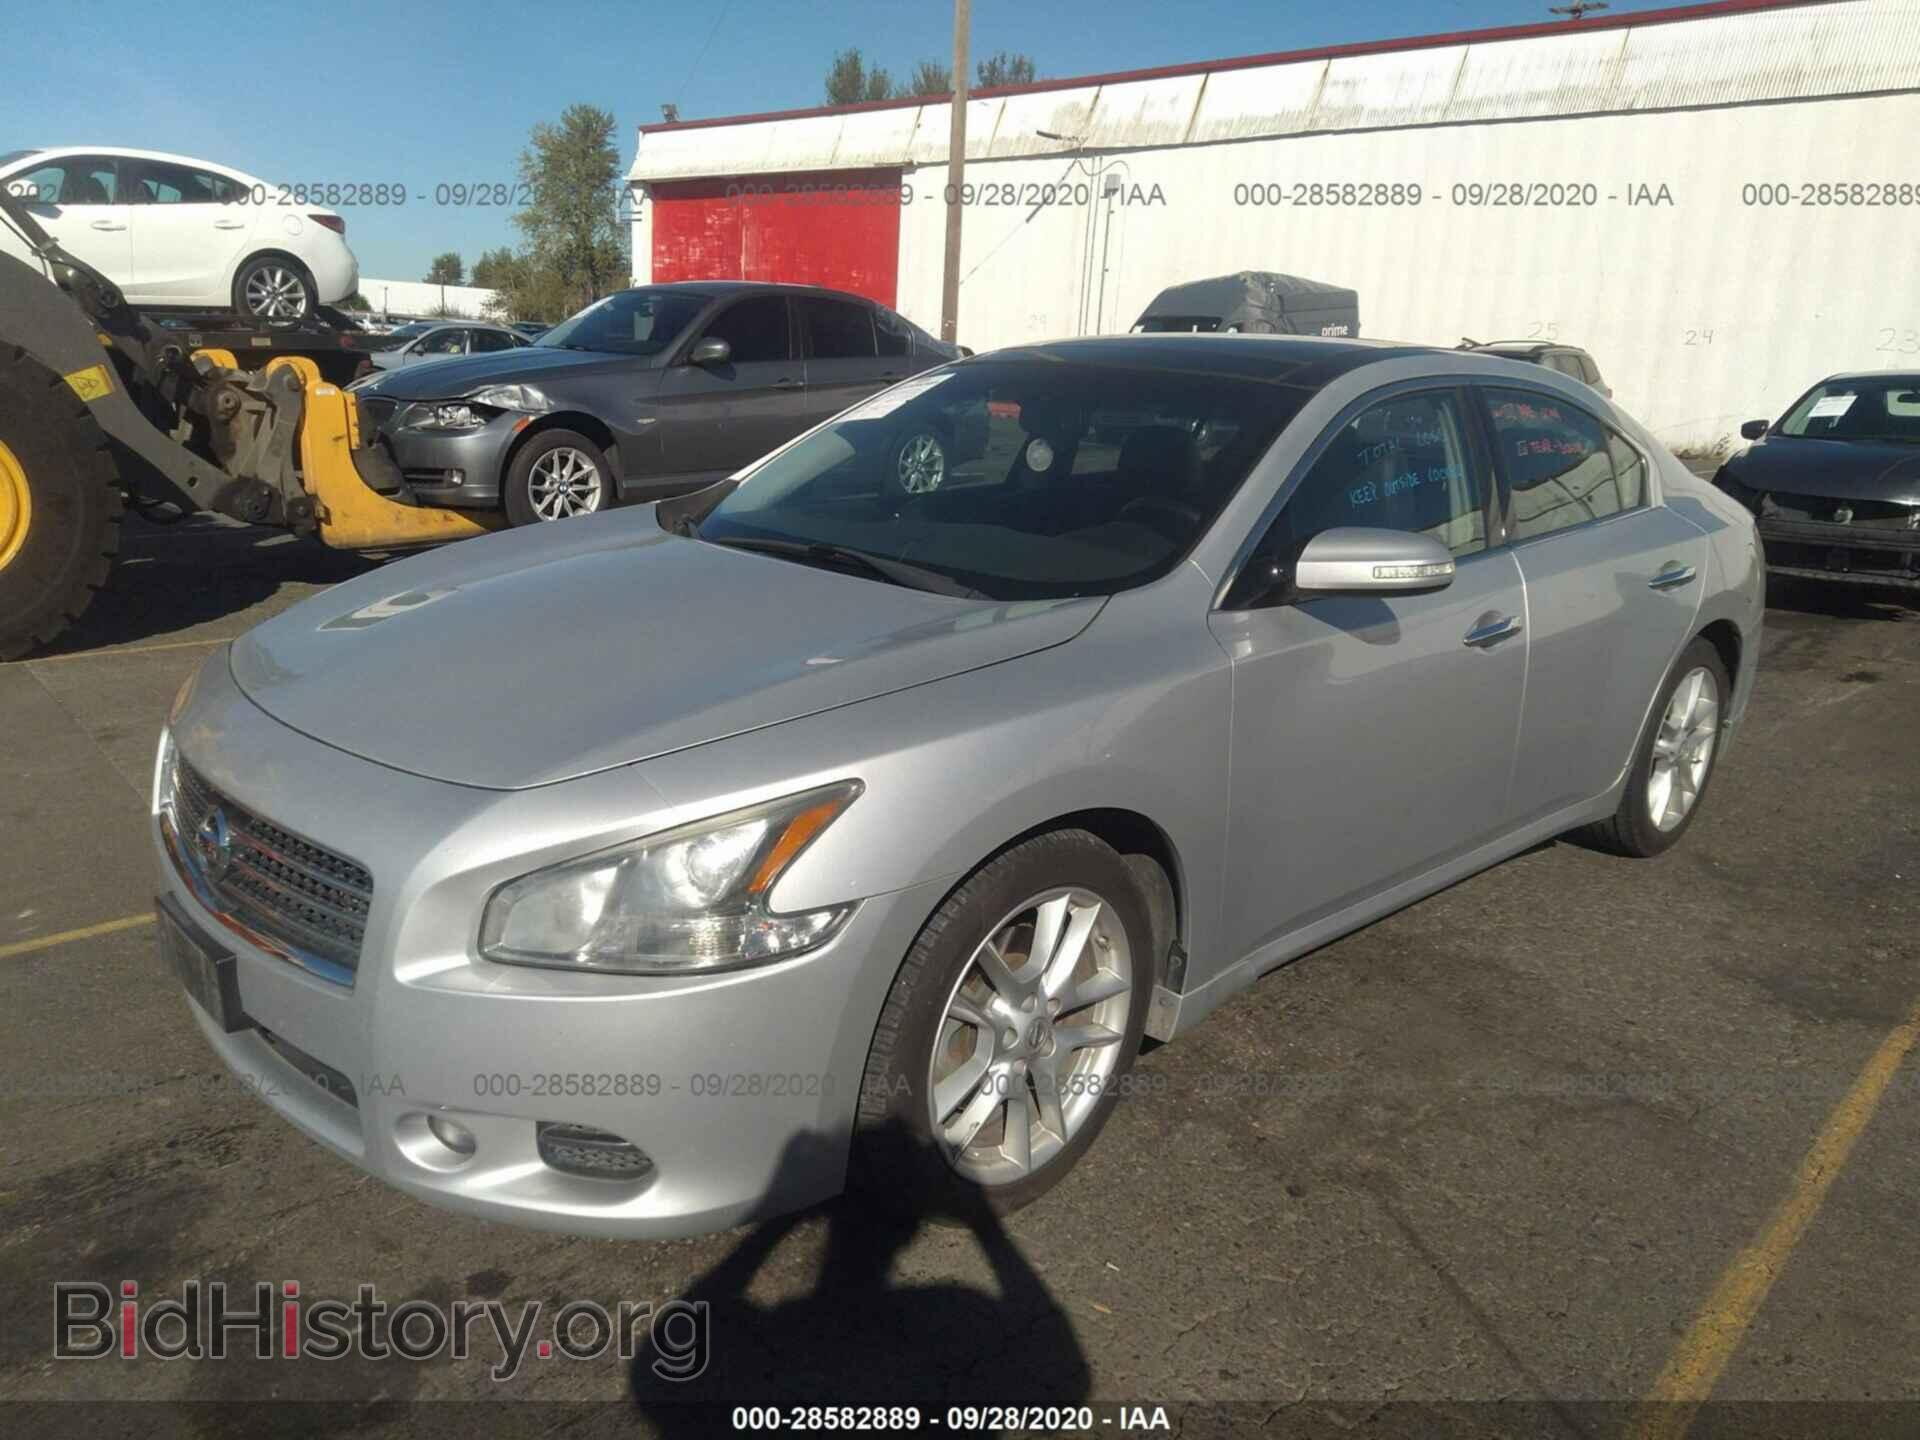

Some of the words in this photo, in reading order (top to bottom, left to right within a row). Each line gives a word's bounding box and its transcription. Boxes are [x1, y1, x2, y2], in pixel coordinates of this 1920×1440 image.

[1321, 323, 1348, 337] prime
[1527, 321, 1560, 342] 25
[1684, 329, 1714, 346] 24
